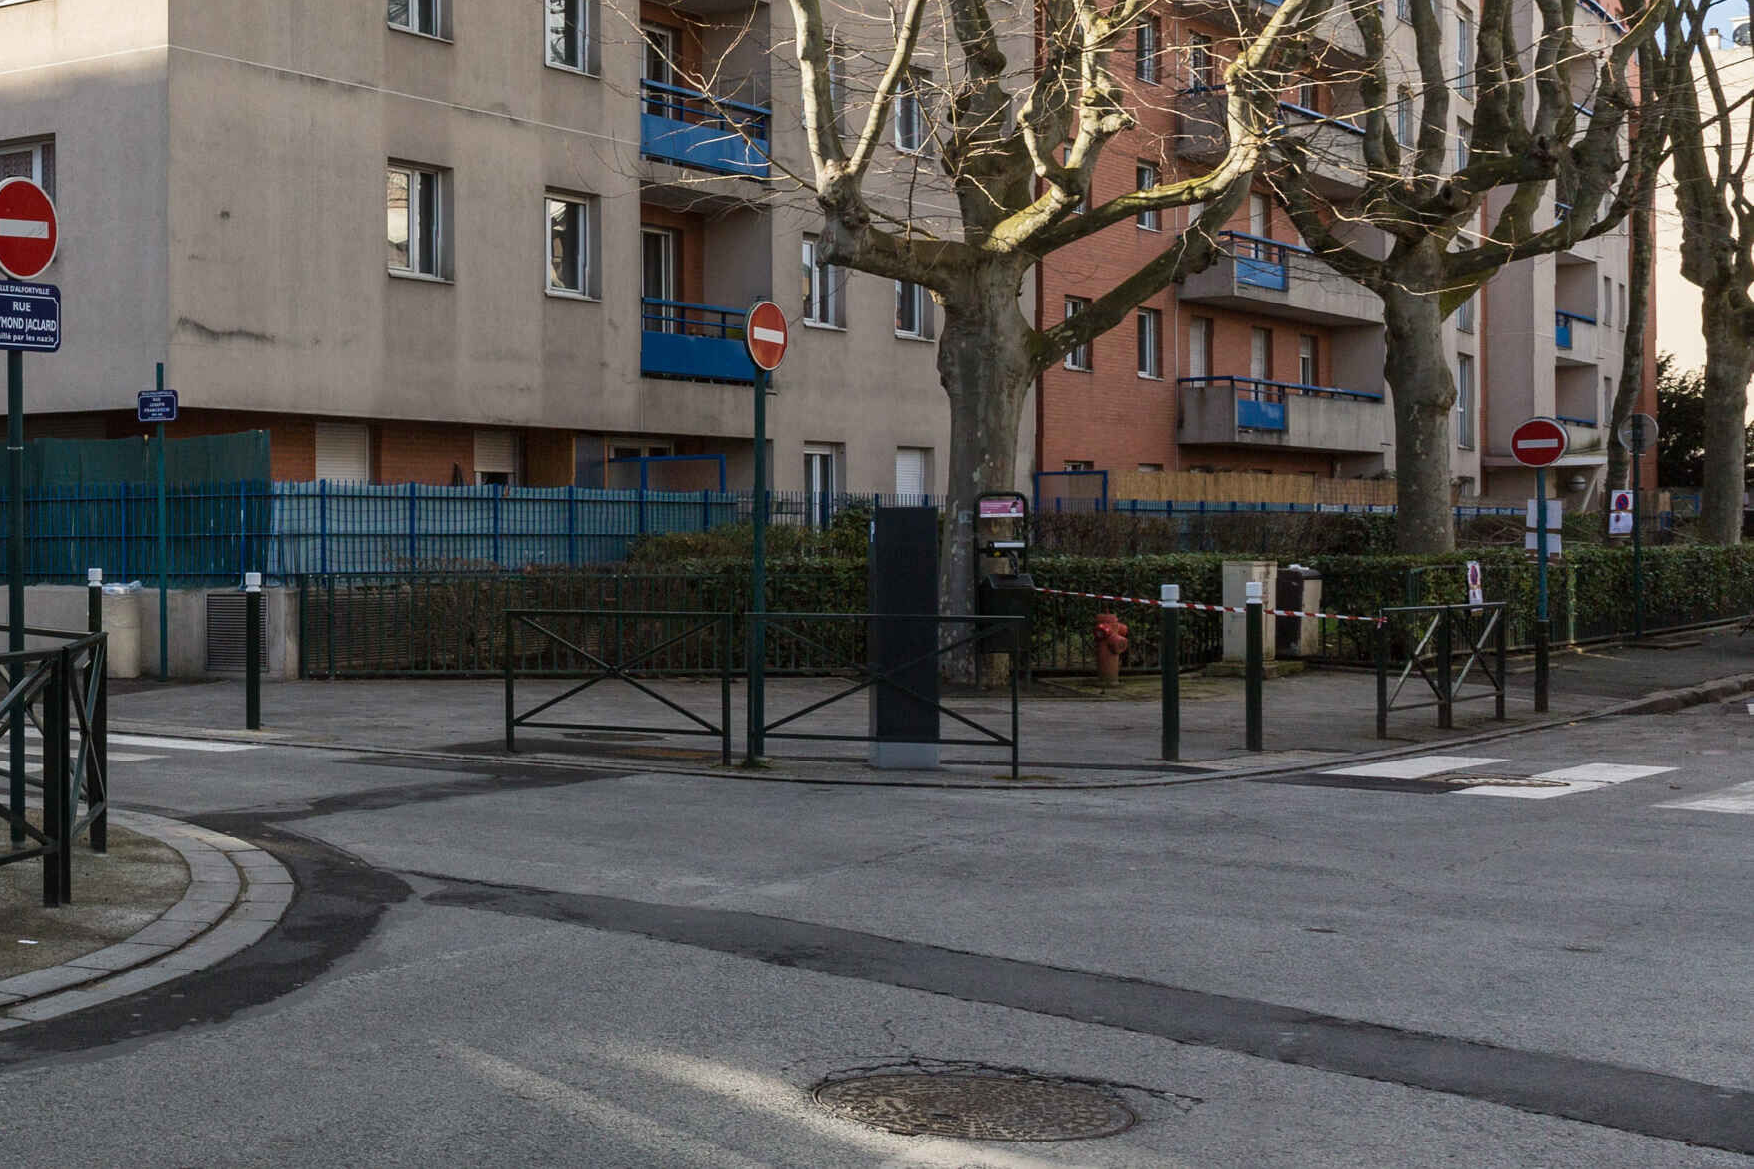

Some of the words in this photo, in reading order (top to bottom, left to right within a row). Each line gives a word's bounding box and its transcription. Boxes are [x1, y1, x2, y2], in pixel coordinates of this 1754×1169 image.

[10, 285, 50, 295] D'ALFORTVILLE
[12, 301, 31, 312] RUE
[25, 318, 57, 333] JACLARD
[13, 334, 24, 342] par
[37, 335, 54, 343] nazis
